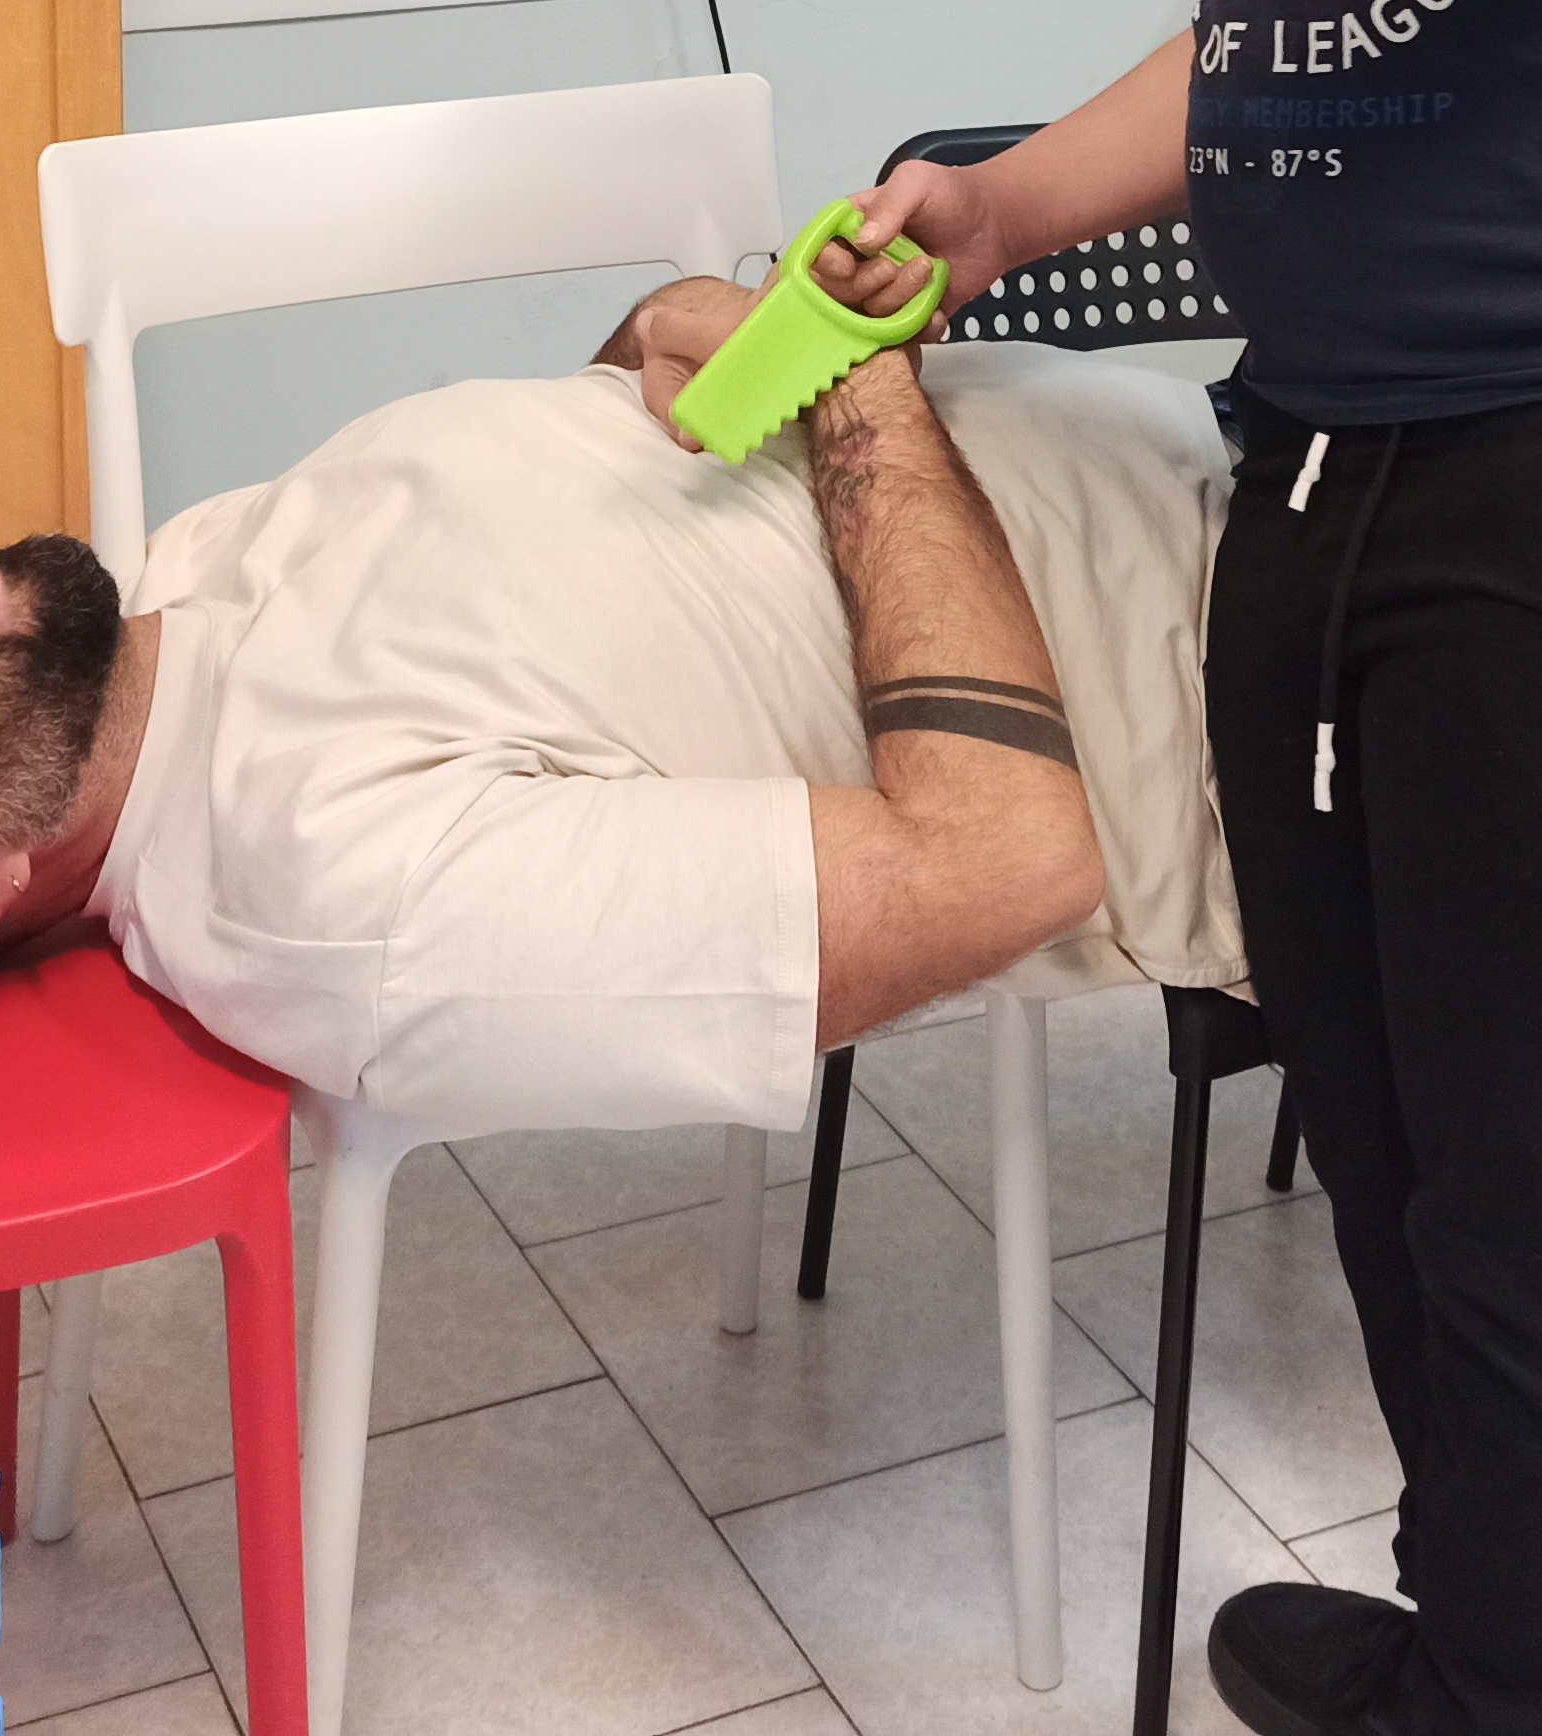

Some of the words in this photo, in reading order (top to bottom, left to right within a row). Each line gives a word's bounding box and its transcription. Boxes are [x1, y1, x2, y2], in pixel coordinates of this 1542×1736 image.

[1200, 21, 1248, 75] OF
[1242, 92, 1455, 129] MEMBERSHIP
[1271, 149, 1343, 178] 87°S
